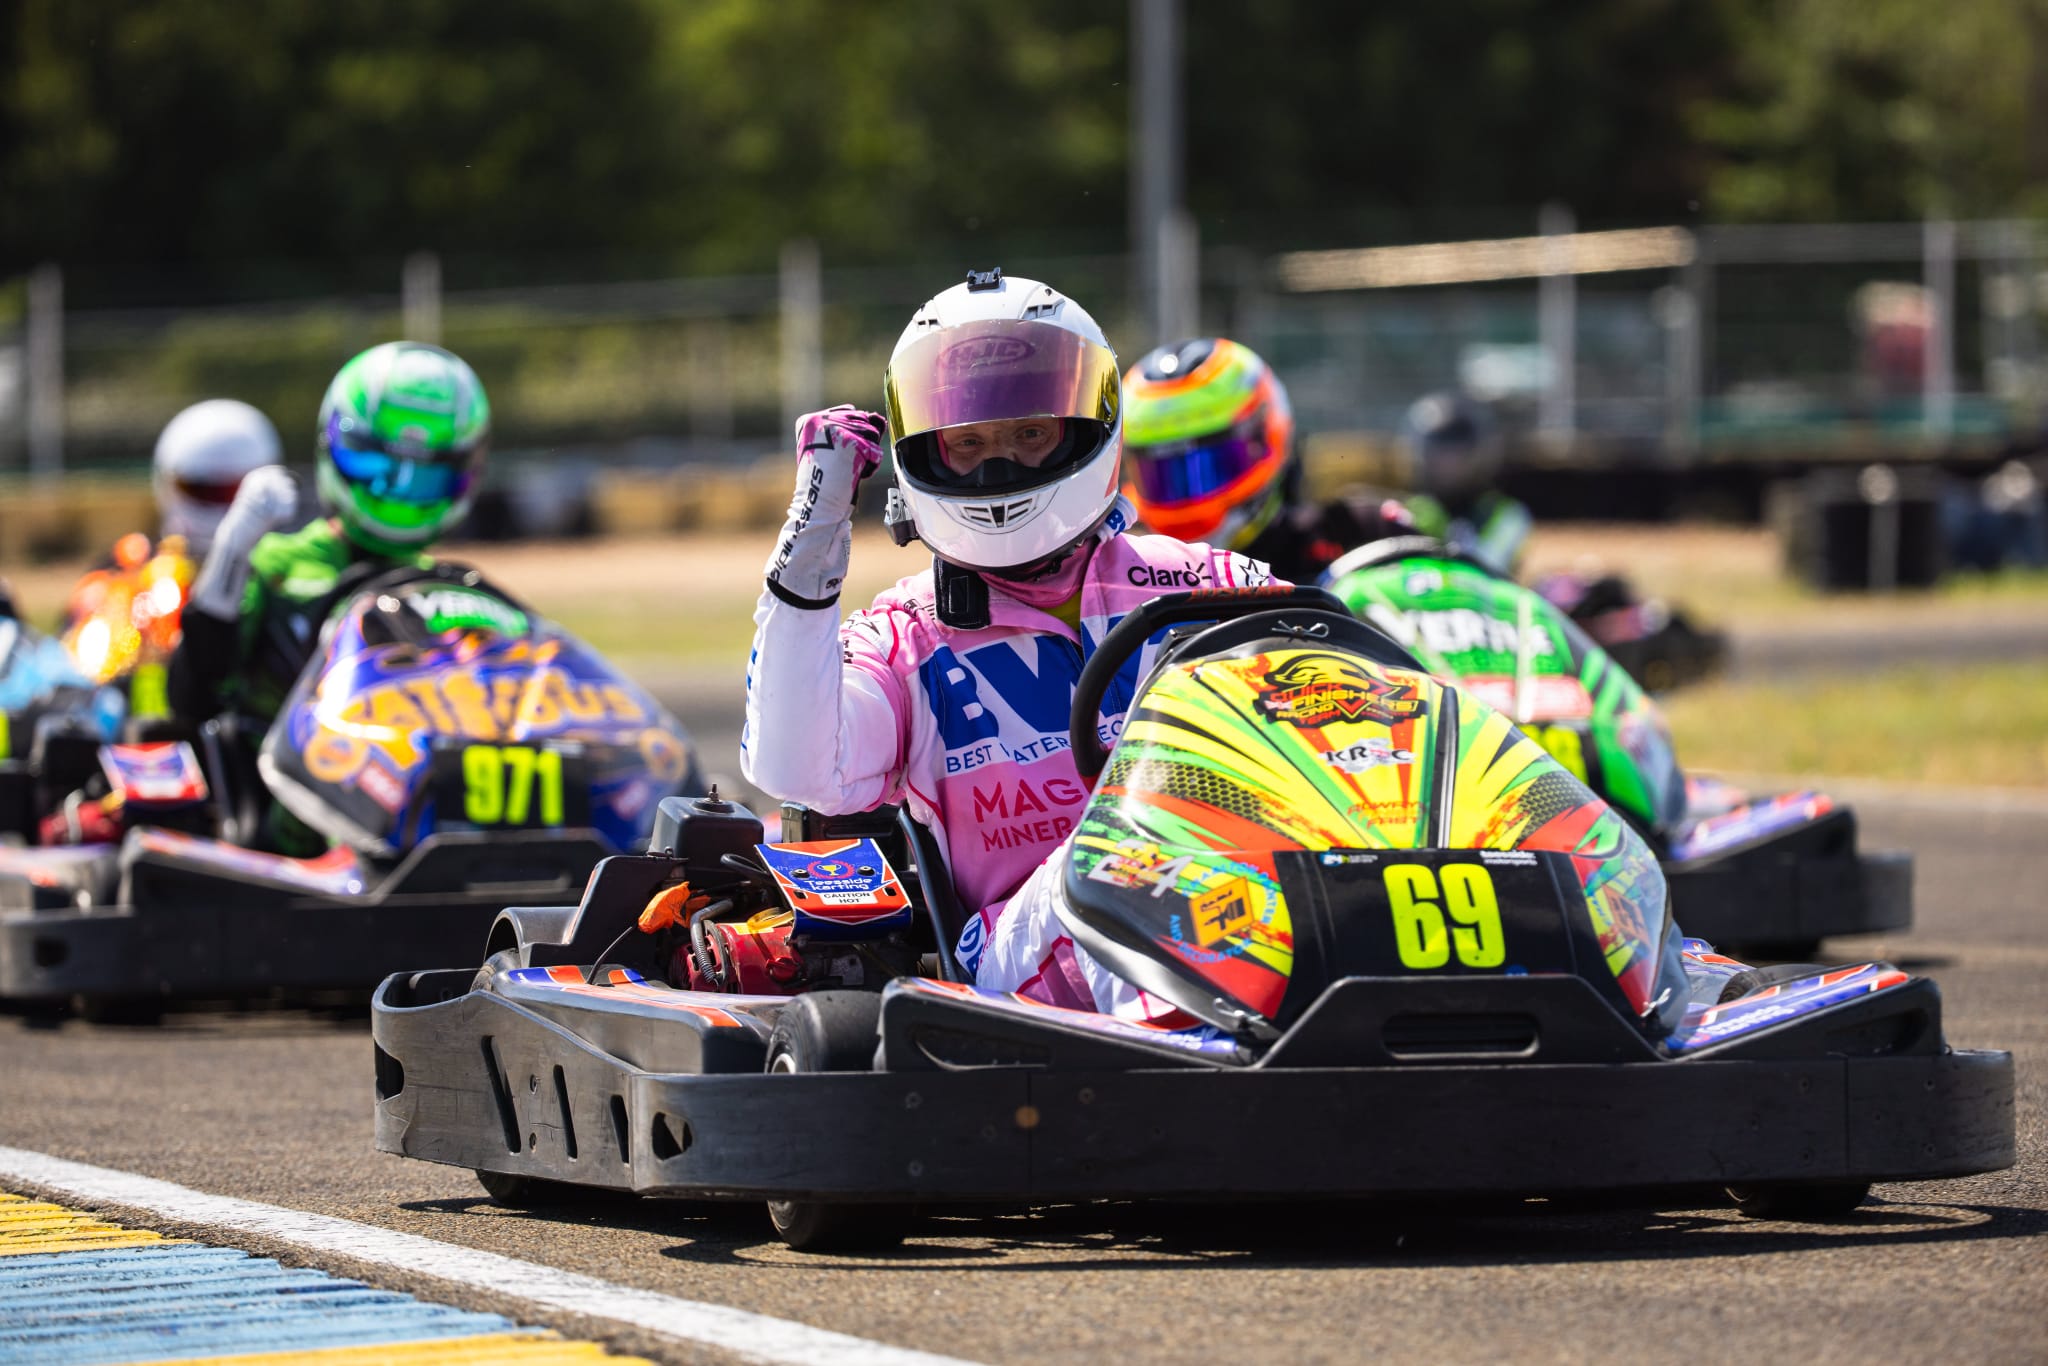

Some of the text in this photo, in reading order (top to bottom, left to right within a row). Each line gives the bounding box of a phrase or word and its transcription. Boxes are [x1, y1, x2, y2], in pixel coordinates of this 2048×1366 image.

[1127, 563, 1203, 588] Claro
[1270, 682, 1343, 702] QUICK
[1276, 704, 1335, 719] RACING
[1300, 710, 1342, 725] TEAM
[946, 744, 992, 773] BEST
[463, 745, 564, 825] 971
[973, 778, 1084, 824] MAG
[981, 816, 1073, 852] MINER
[804, 878, 873, 886] Teesside
[1169, 914, 1184, 942] AND
[1383, 863, 1506, 970] 69
